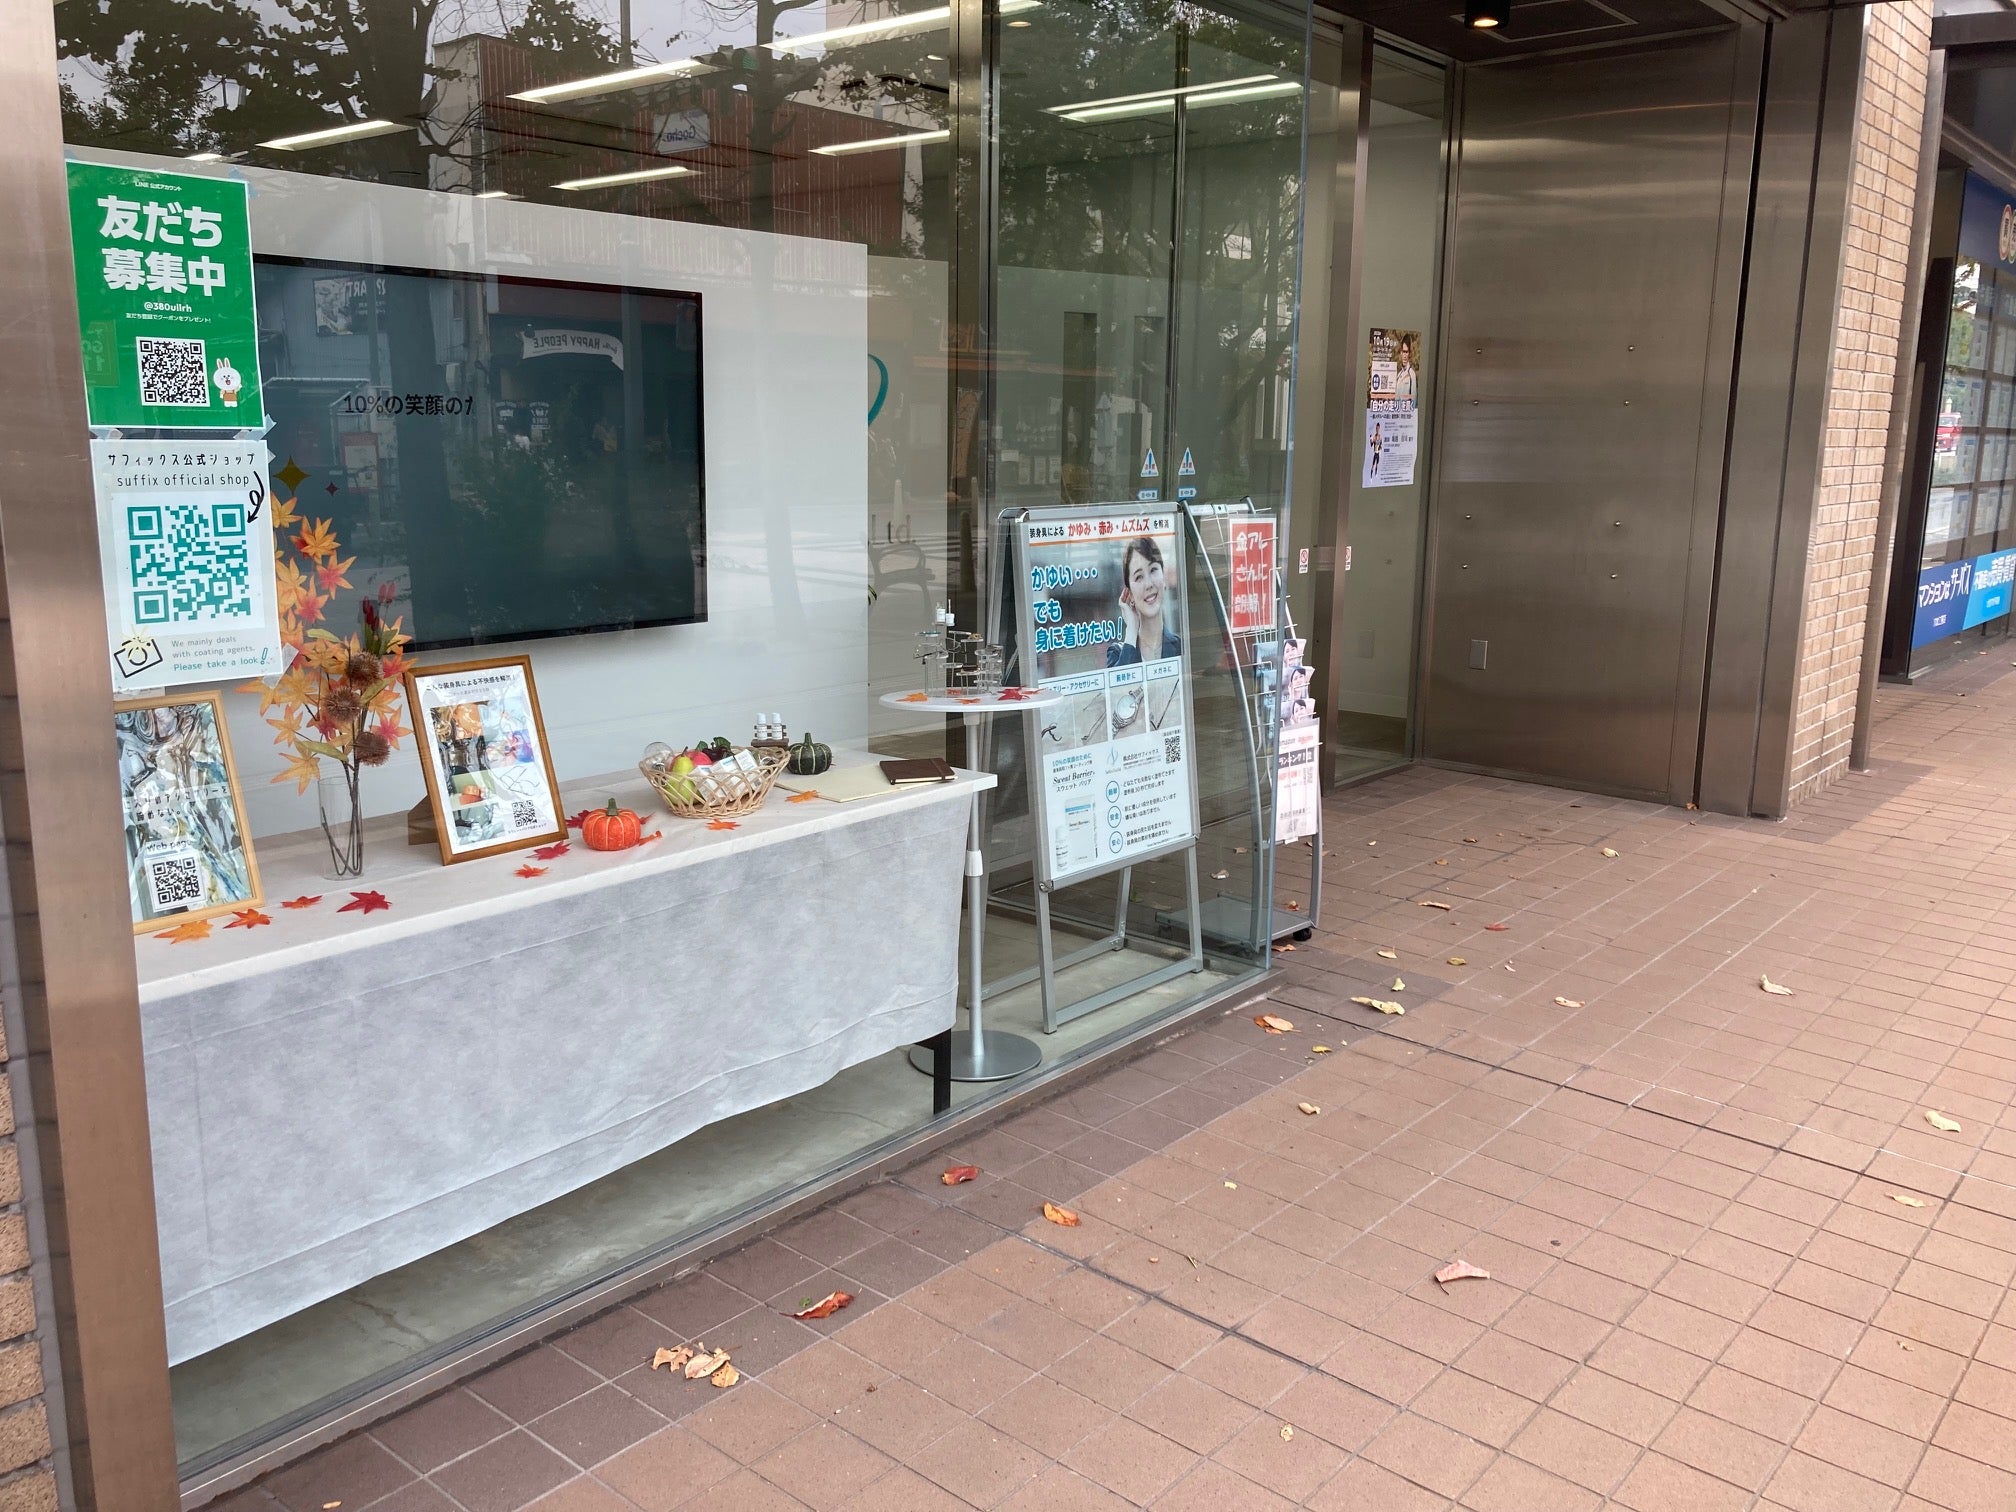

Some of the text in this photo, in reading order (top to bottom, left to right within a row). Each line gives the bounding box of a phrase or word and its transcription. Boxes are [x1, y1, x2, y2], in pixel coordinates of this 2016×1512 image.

[97, 194, 223, 247] 友だち
[101, 247, 226, 297] 募集中
[108, 453, 256, 467] サフィックス公式ショップ
[117, 473, 250, 487] suffix official shop
[1067, 517, 1150, 538] かゆみ・赤み・ムズムズ
[1033, 598, 1062, 623] でも
[171, 635, 237, 648] We mainly deals
[172, 651, 191, 659] with
[194, 647, 224, 657] coating
[173, 662, 203, 671] Please
[207, 659, 227, 669] take
